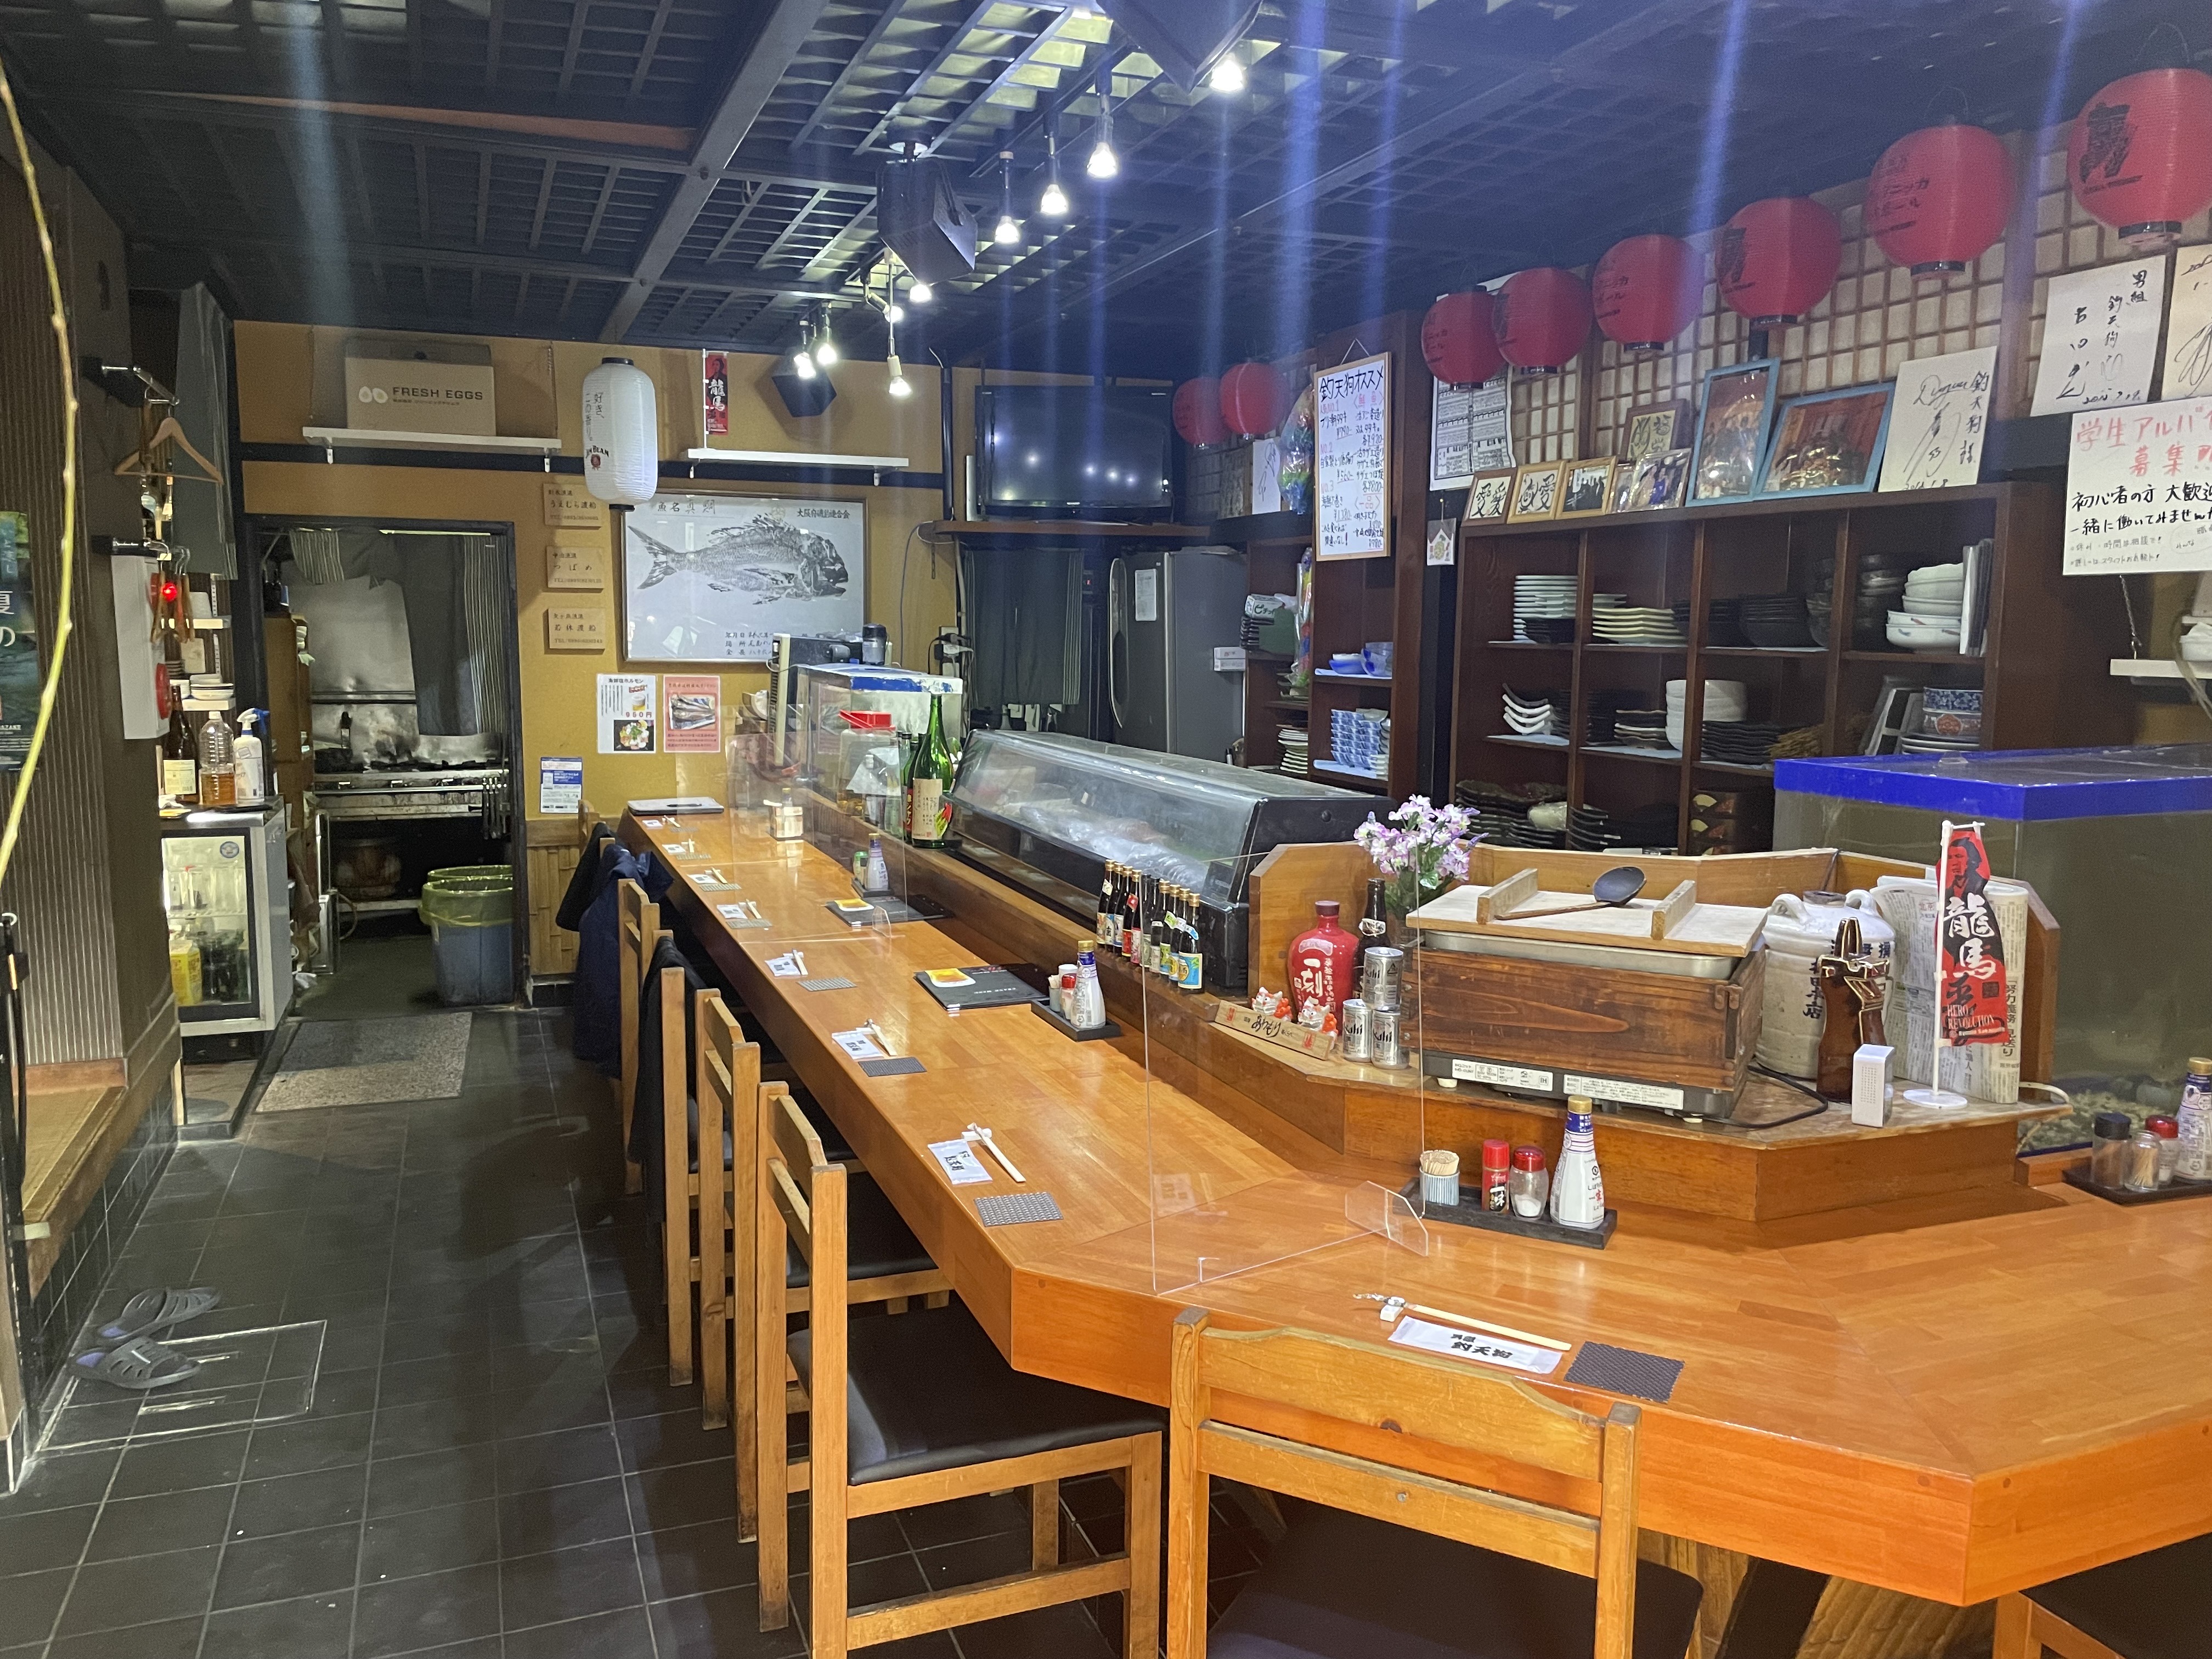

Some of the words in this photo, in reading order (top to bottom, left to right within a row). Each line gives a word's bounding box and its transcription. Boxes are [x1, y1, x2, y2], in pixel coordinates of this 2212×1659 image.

[393, 387, 439, 398] FRESH
[445, 390, 483, 400] EGGS
[1319, 365, 1384, 402] 釣天狗オススメ
[2072, 484, 2157, 512] 初心者の方
[1943, 892, 1997, 980] 龍馬
[1299, 958, 1324, 1006] 一刻
[1947, 1005, 1969, 1018] HERO
[1489, 1186, 1505, 1206] 一味
[1451, 1341, 1513, 1359] 釣天狗
